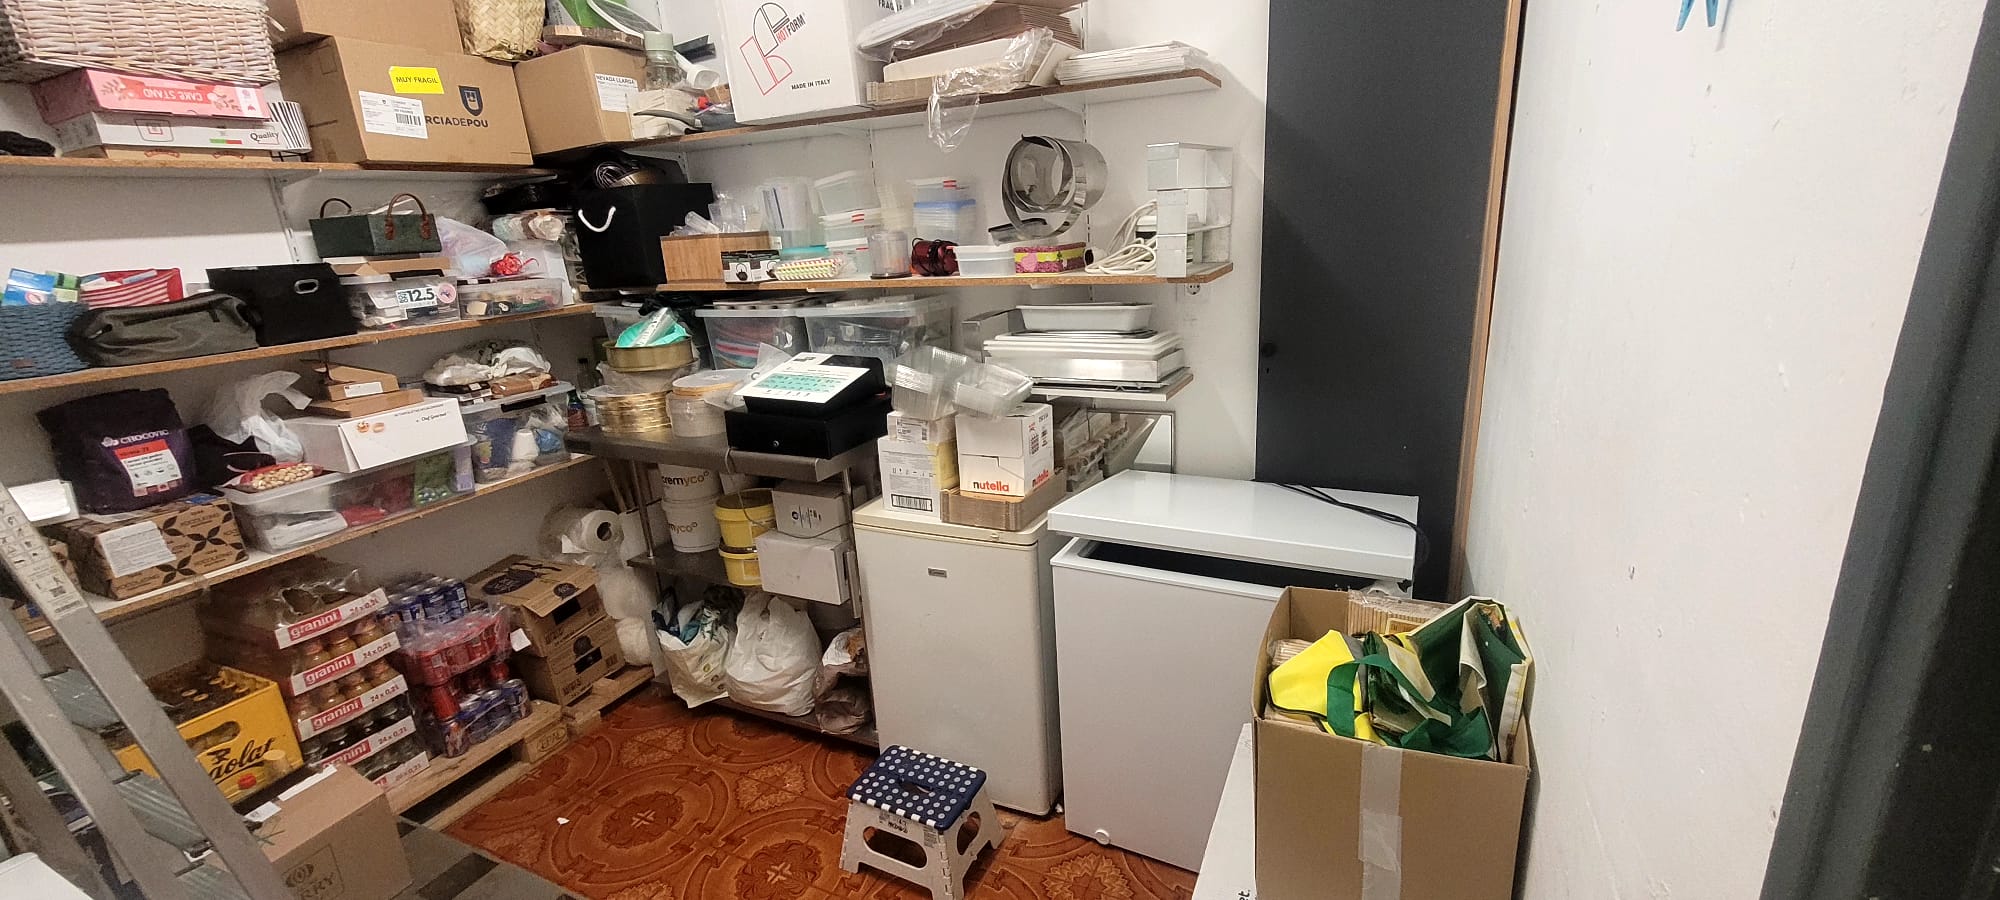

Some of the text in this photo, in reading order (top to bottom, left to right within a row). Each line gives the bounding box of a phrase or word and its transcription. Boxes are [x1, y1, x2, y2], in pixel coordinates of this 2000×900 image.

[776, 15, 806, 43] HOTFORM
[791, 82, 806, 90] MADE
[815, 78, 831, 87] ITALY
[143, 88, 178, 100] STAND
[425, 115, 489, 128] RCIADEPOU
[250, 130, 280, 142] Quality
[973, 480, 1010, 492] nutella
[290, 612, 338, 637] granini
[306, 657, 351, 684] granini
[313, 701, 359, 728] granini
